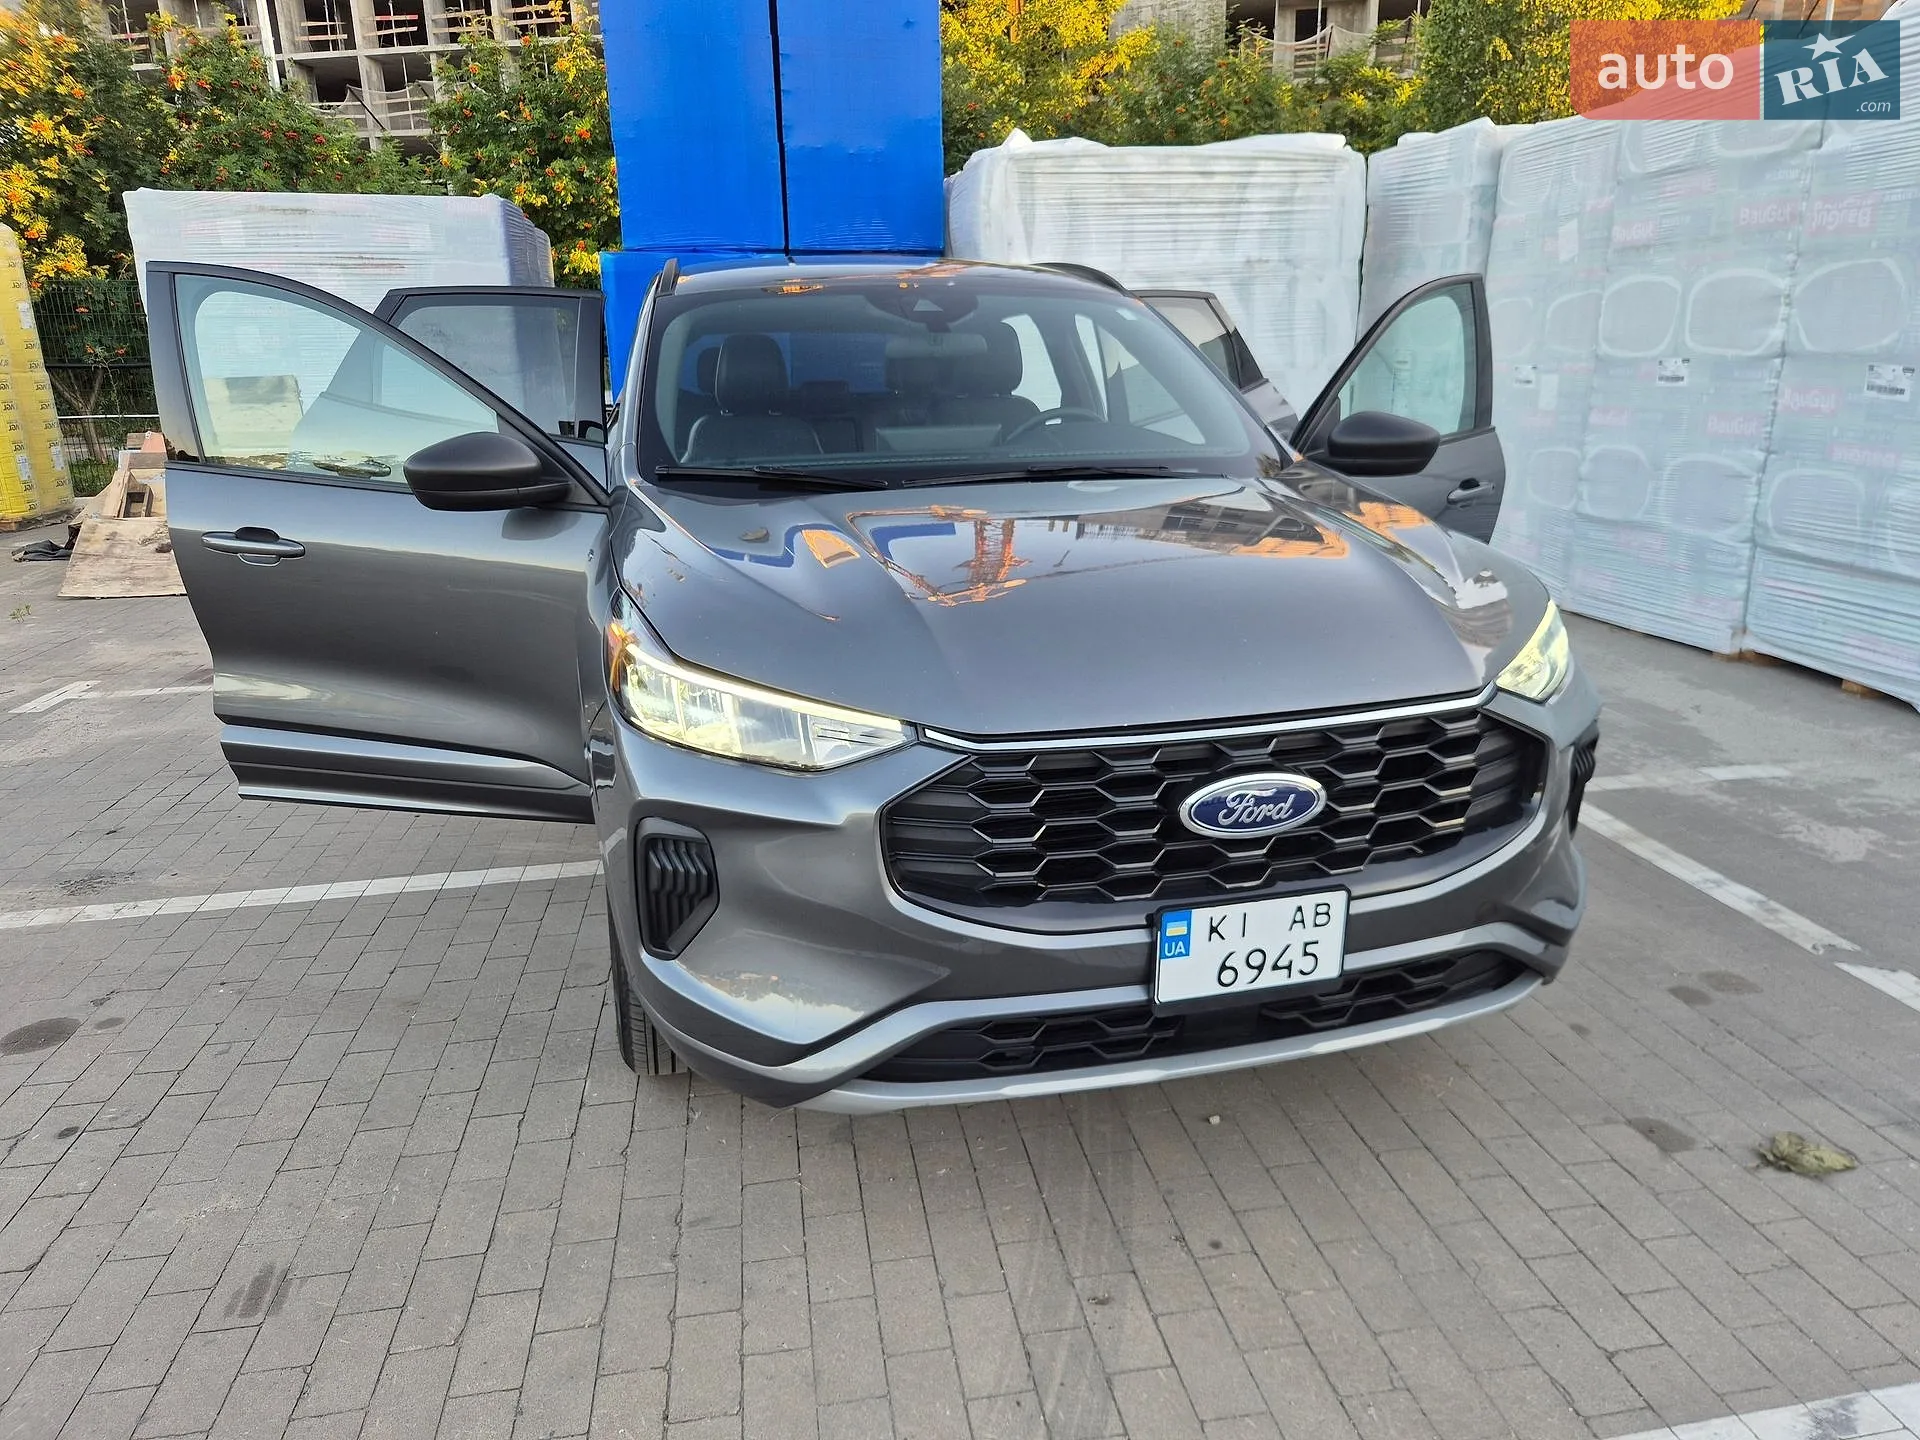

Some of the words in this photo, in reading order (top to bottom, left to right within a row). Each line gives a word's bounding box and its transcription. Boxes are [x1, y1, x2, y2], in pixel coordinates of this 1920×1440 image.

[1217, 787, 1296, 826] Ford
[1208, 912, 1247, 942] KI
[1289, 903, 1331, 931] AB
[1164, 942, 1186, 957] UA
[1217, 940, 1319, 988] 6945
